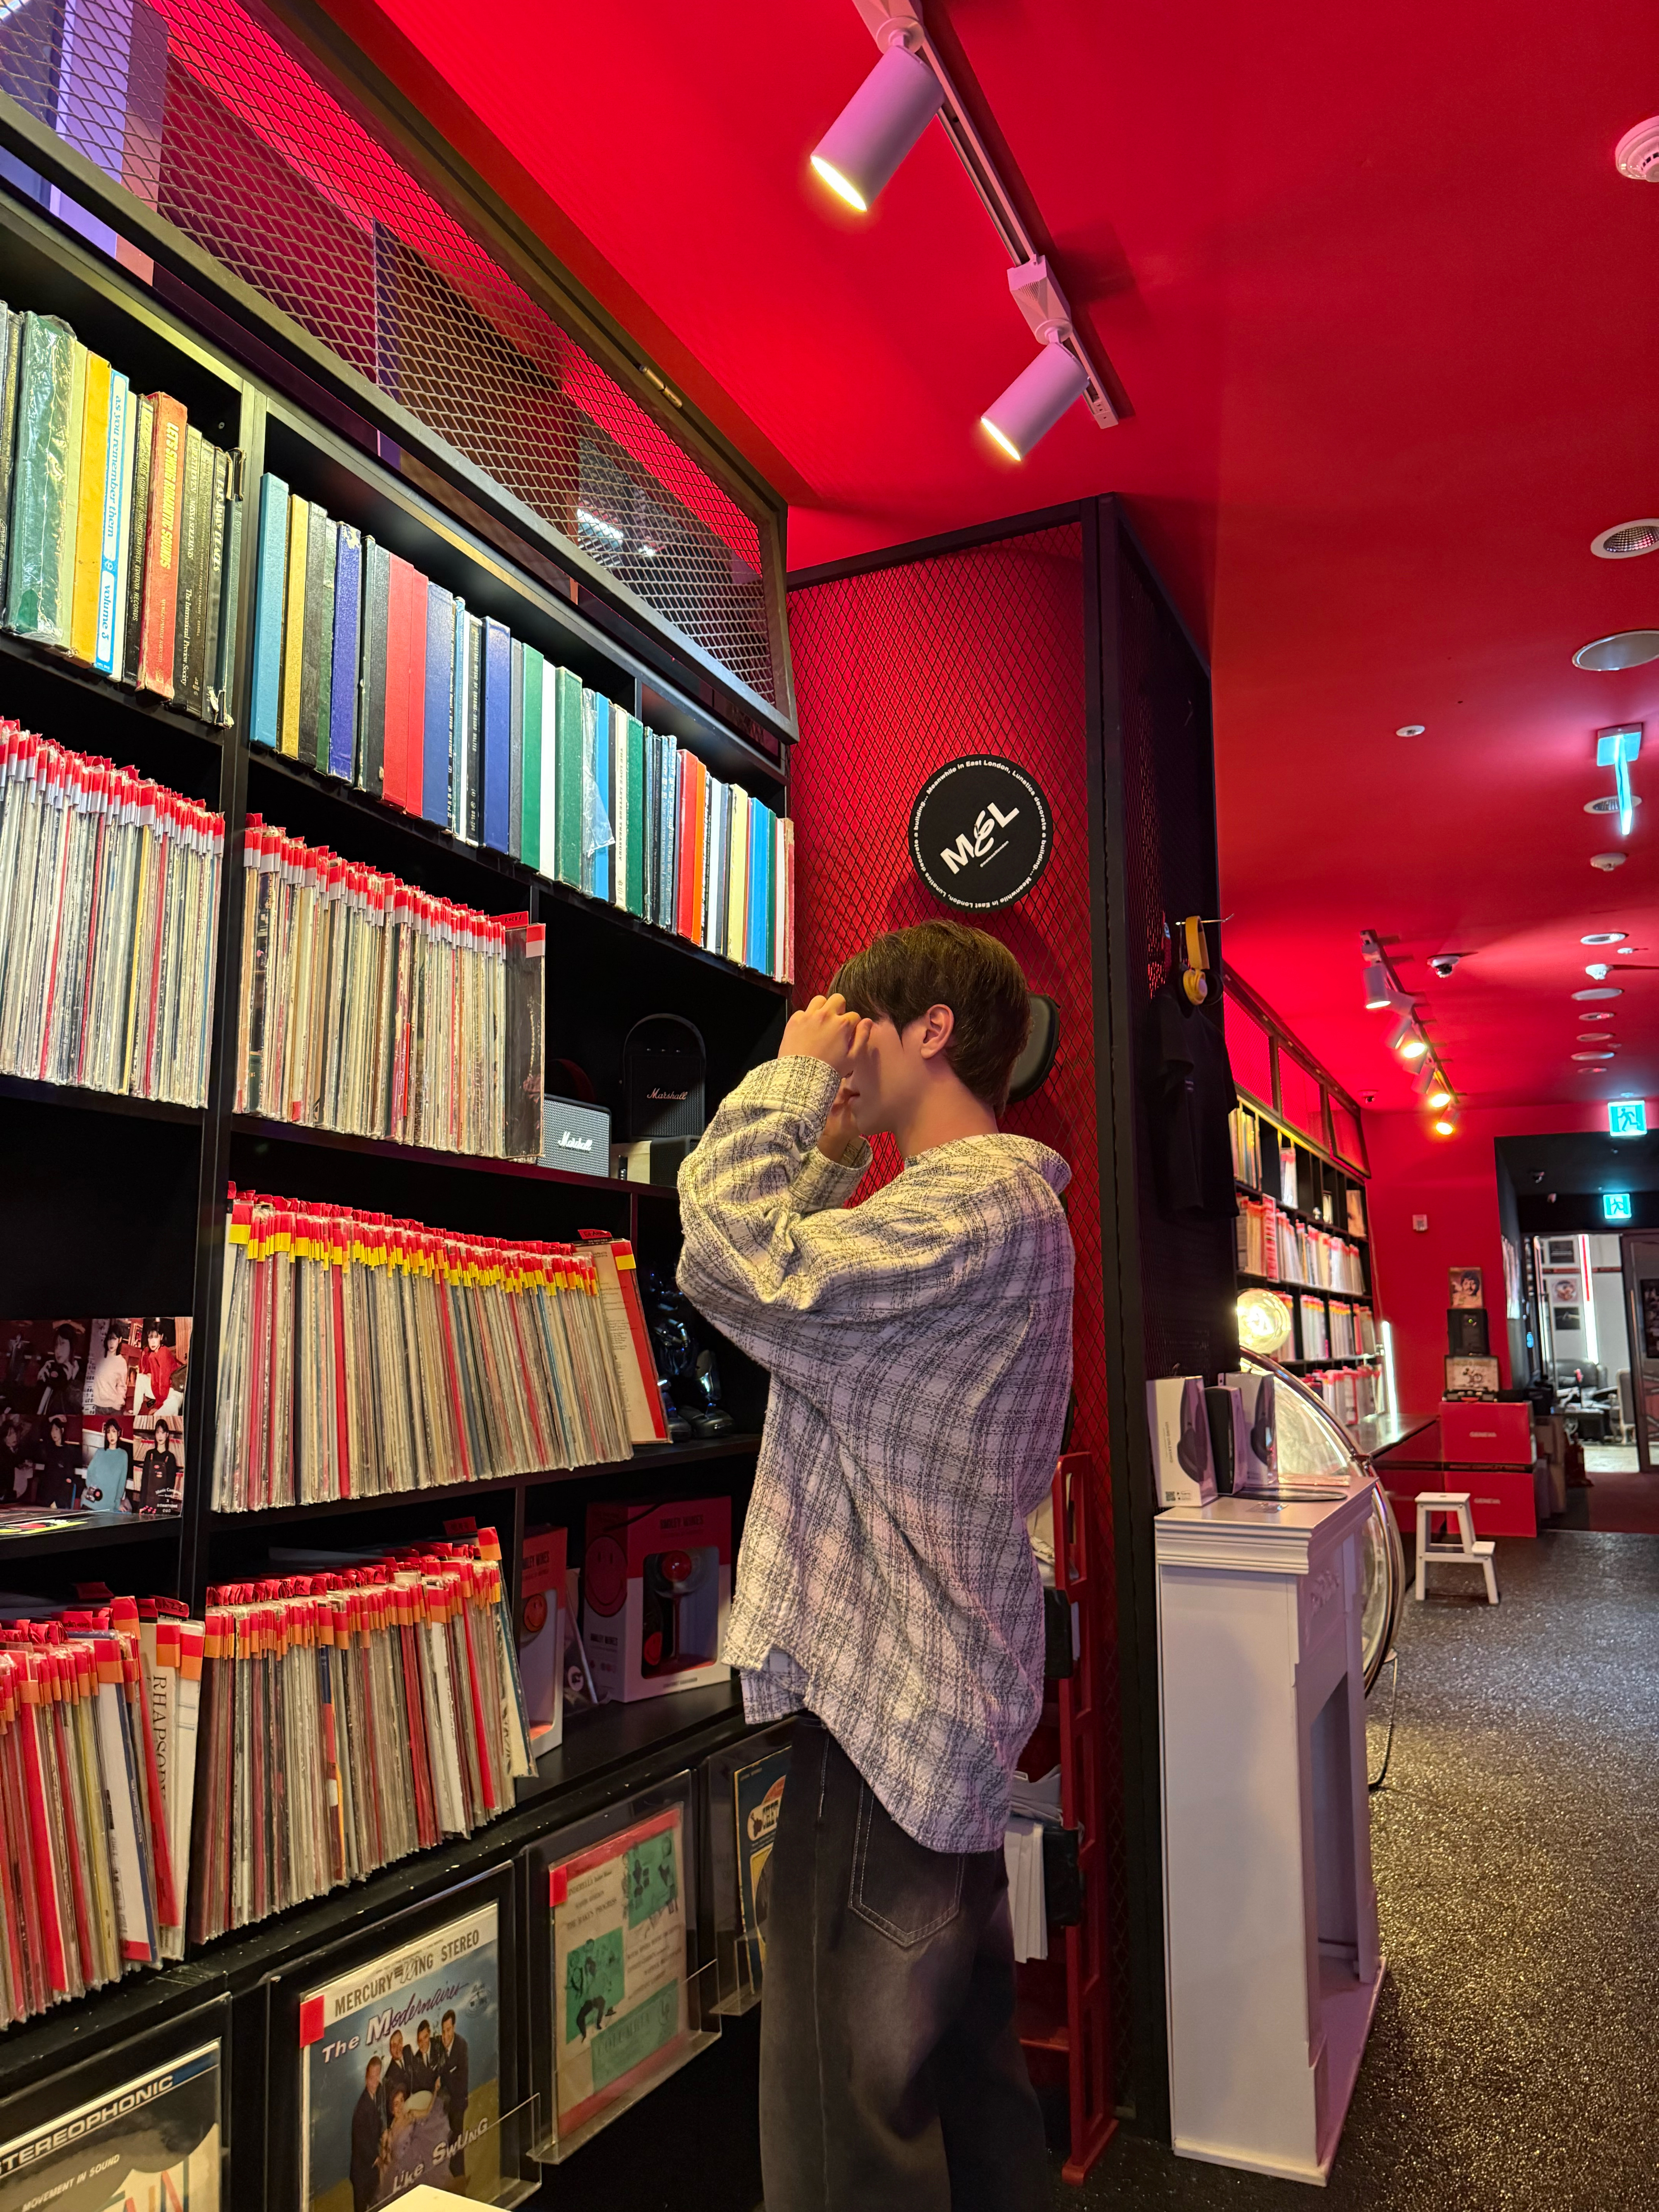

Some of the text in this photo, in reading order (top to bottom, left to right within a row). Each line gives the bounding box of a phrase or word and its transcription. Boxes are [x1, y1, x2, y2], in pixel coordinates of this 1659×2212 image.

[115, 395, 122, 410] as
[109, 438, 120, 503] remember
[190, 447, 198, 494] BEETHOVEN
[160, 422, 179, 570] LET'S SWING ROMANTIC SOUNDS
[108, 505, 117, 538] them
[213, 530, 222, 573] PLACES
[101, 585, 112, 640] volume 3
[184, 601, 192, 640] International
[180, 664, 189, 686] Society
[926, 767, 957, 795] Meanwhile
[983, 759, 1011, 774] London,
[1012, 770, 1036, 796] Lunatics
[1034, 796, 1047, 831] decorate
[914, 839, 926, 872] decorate
[948, 894, 974, 908] London,
[1000, 876, 1032, 903] Meanwhile
[647, 1087, 688, 1100] Marshall
[558, 1130, 593, 1151] Marshall
[335, 1972, 394, 2017] MERCURY
[441, 1929, 479, 1962] STEREO
[322, 1982, 469, 2064] The Modernaires
[22, 2154, 120, 2212] MOVEMENT IN SOUND
